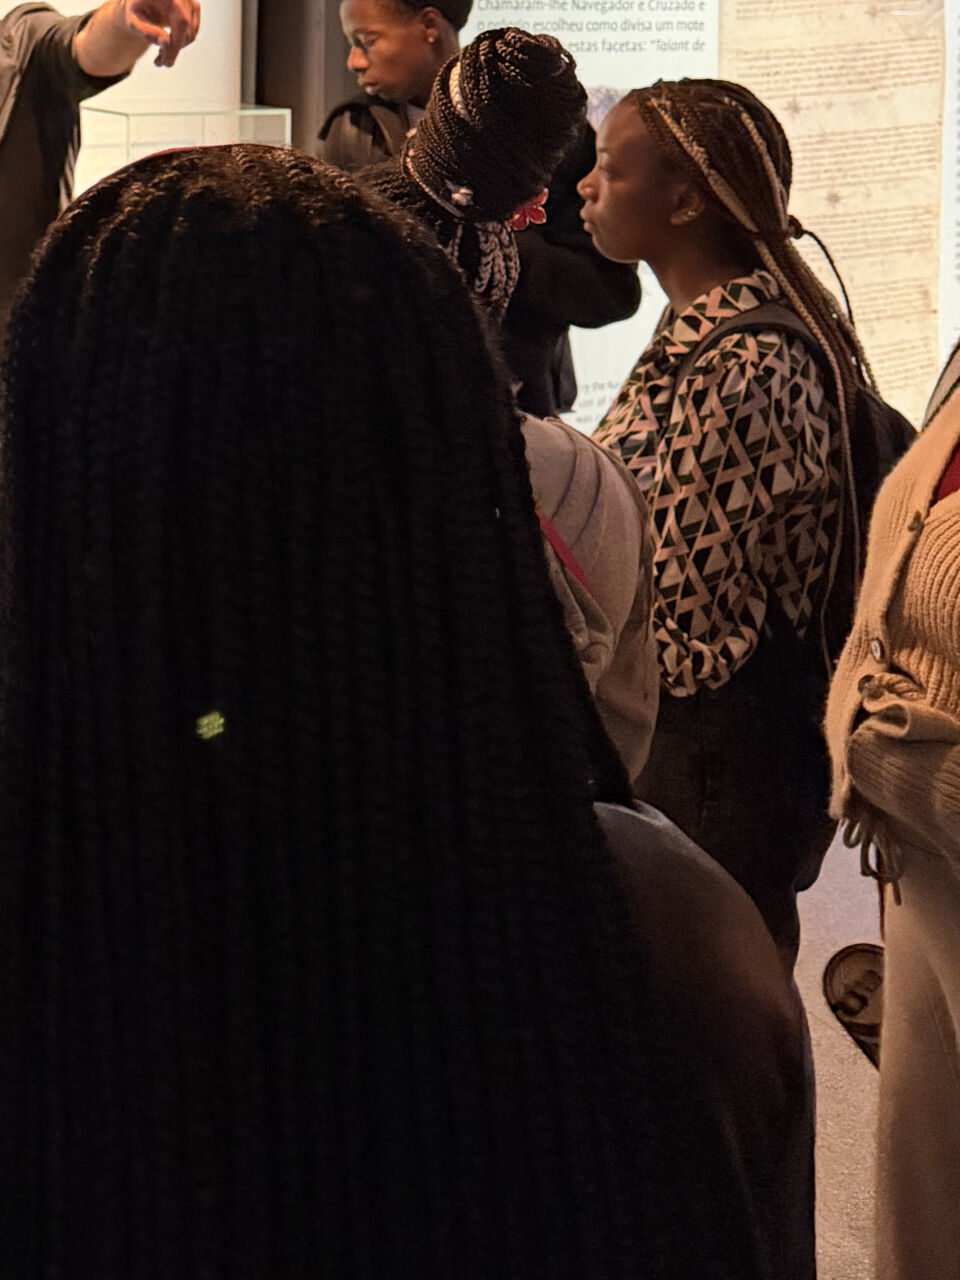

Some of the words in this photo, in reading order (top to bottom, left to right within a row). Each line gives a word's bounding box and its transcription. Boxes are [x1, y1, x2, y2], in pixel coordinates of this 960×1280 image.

[637, 1, 645, 12] e
[698, 1, 705, 12] e
[533, 19, 584, 33] escolheu
[585, 21, 618, 33] como
[619, 18, 653, 33] divisa
[655, 22, 674, 33] um
[676, 20, 705, 33] mote
